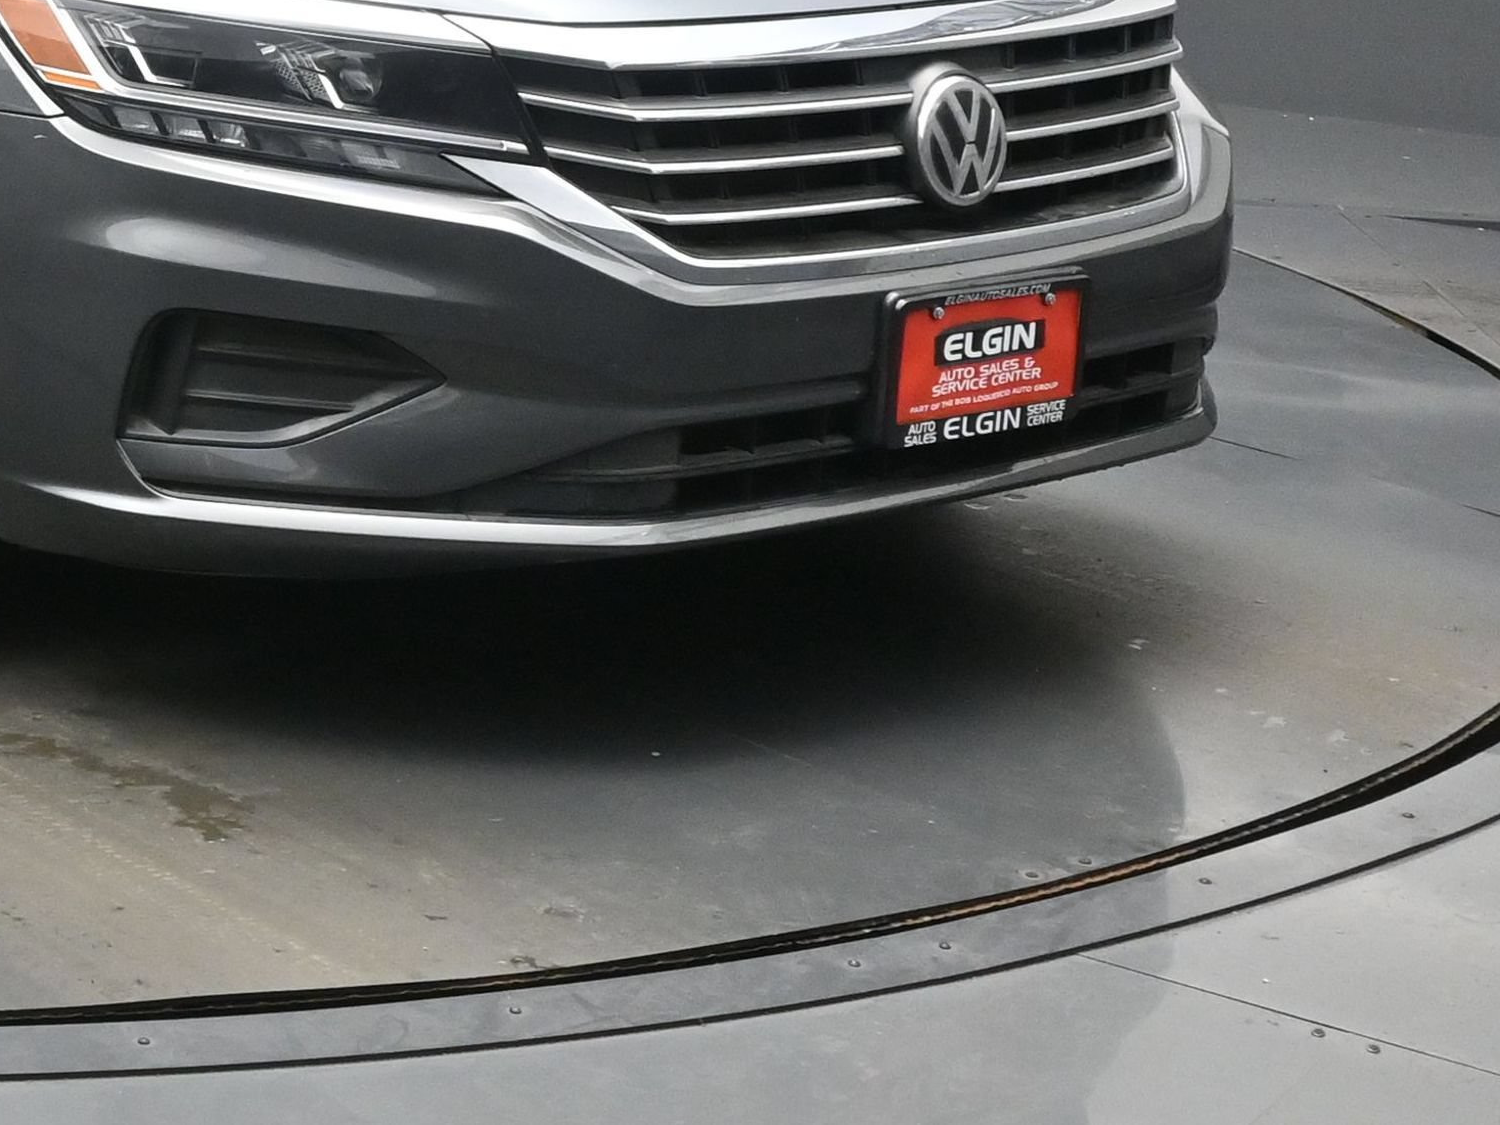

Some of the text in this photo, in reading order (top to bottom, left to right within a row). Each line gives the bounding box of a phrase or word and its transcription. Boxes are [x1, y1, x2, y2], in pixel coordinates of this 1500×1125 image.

[926, 84, 1003, 199] VW
[944, 283, 1052, 306] ELGINAUTOSALES.COM
[943, 322, 1037, 362] ELGIN
[931, 367, 1042, 398] SERVICE CENTER
[938, 356, 1036, 384] AUTO SALES &
[909, 404, 929, 414] PART
[930, 402, 941, 411] OF
[941, 398, 954, 409] THE
[954, 396, 972, 406] BOB
[1012, 385, 1033, 395] AUTO
[1033, 381, 1059, 392] GROUP
[1026, 399, 1067, 416] SERVICE
[908, 421, 937, 436] AUTO
[943, 407, 1022, 441] ELGIN
[1026, 410, 1064, 427] CENTER
[904, 431, 938, 448] SALES
